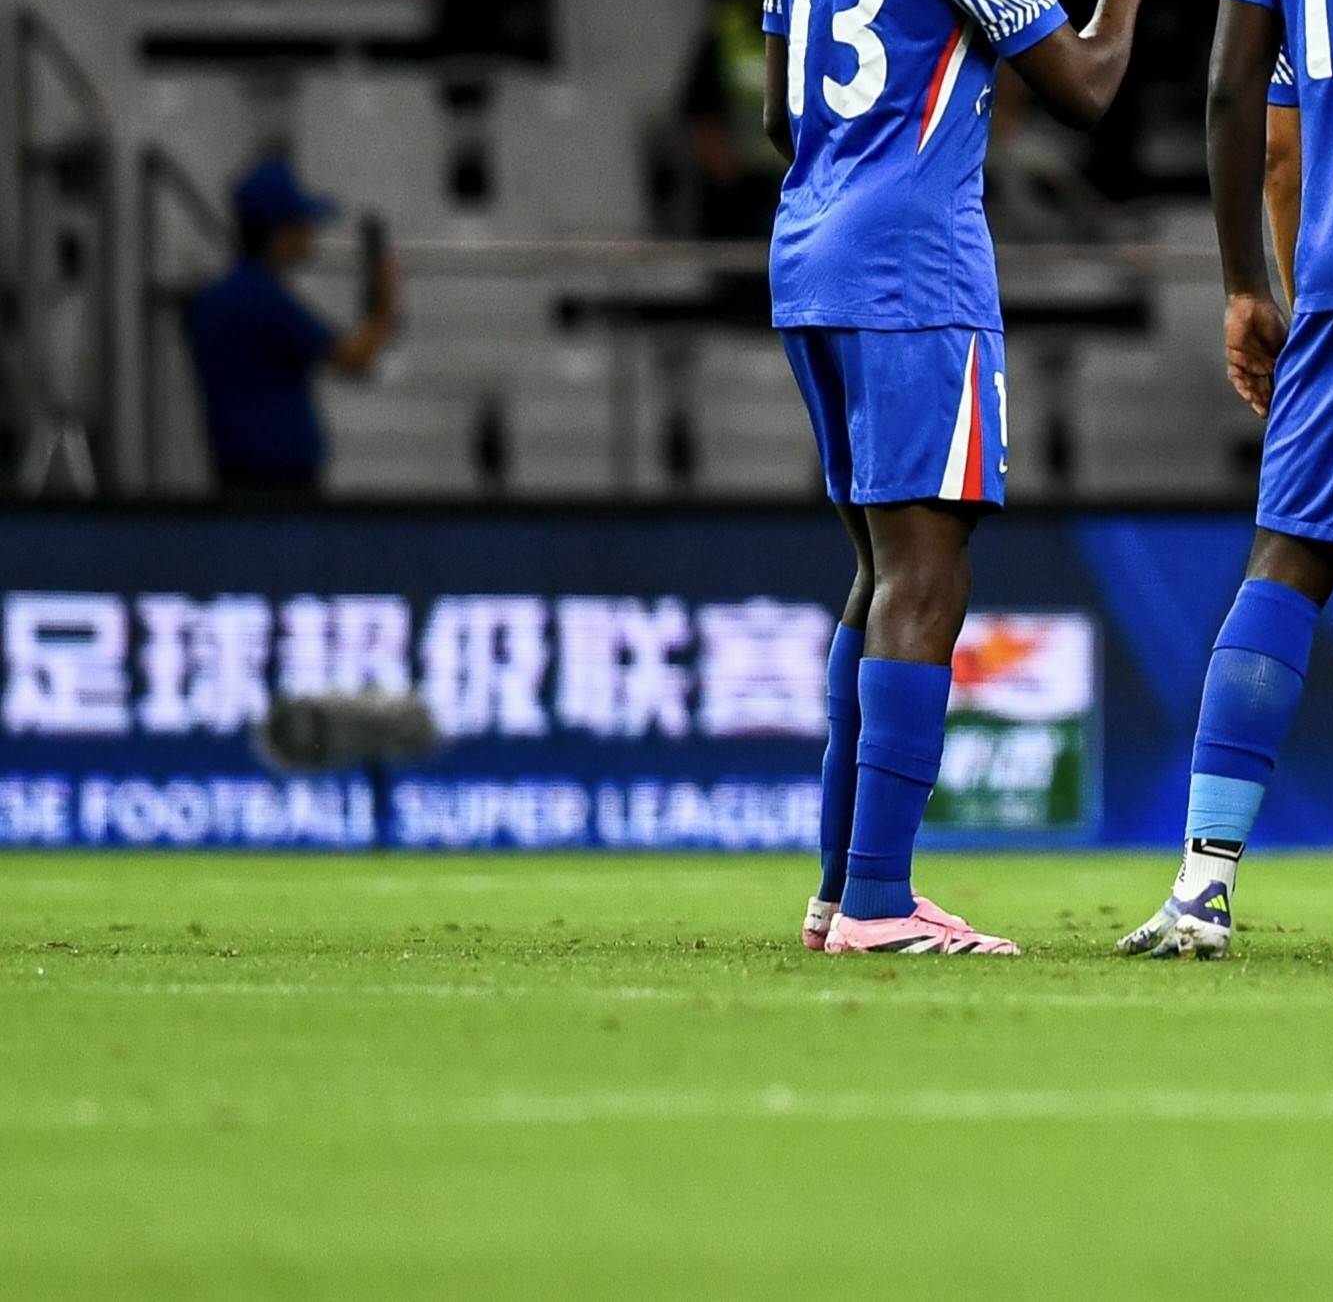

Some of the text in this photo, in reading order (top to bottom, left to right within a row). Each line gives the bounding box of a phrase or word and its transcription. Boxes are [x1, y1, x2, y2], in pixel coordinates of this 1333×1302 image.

[3, 594, 831, 737] 足球超级联赛
[79, 777, 376, 843] FOOTBALL
[394, 779, 588, 846] SUPER
[599, 781, 822, 848] LEAGUE
